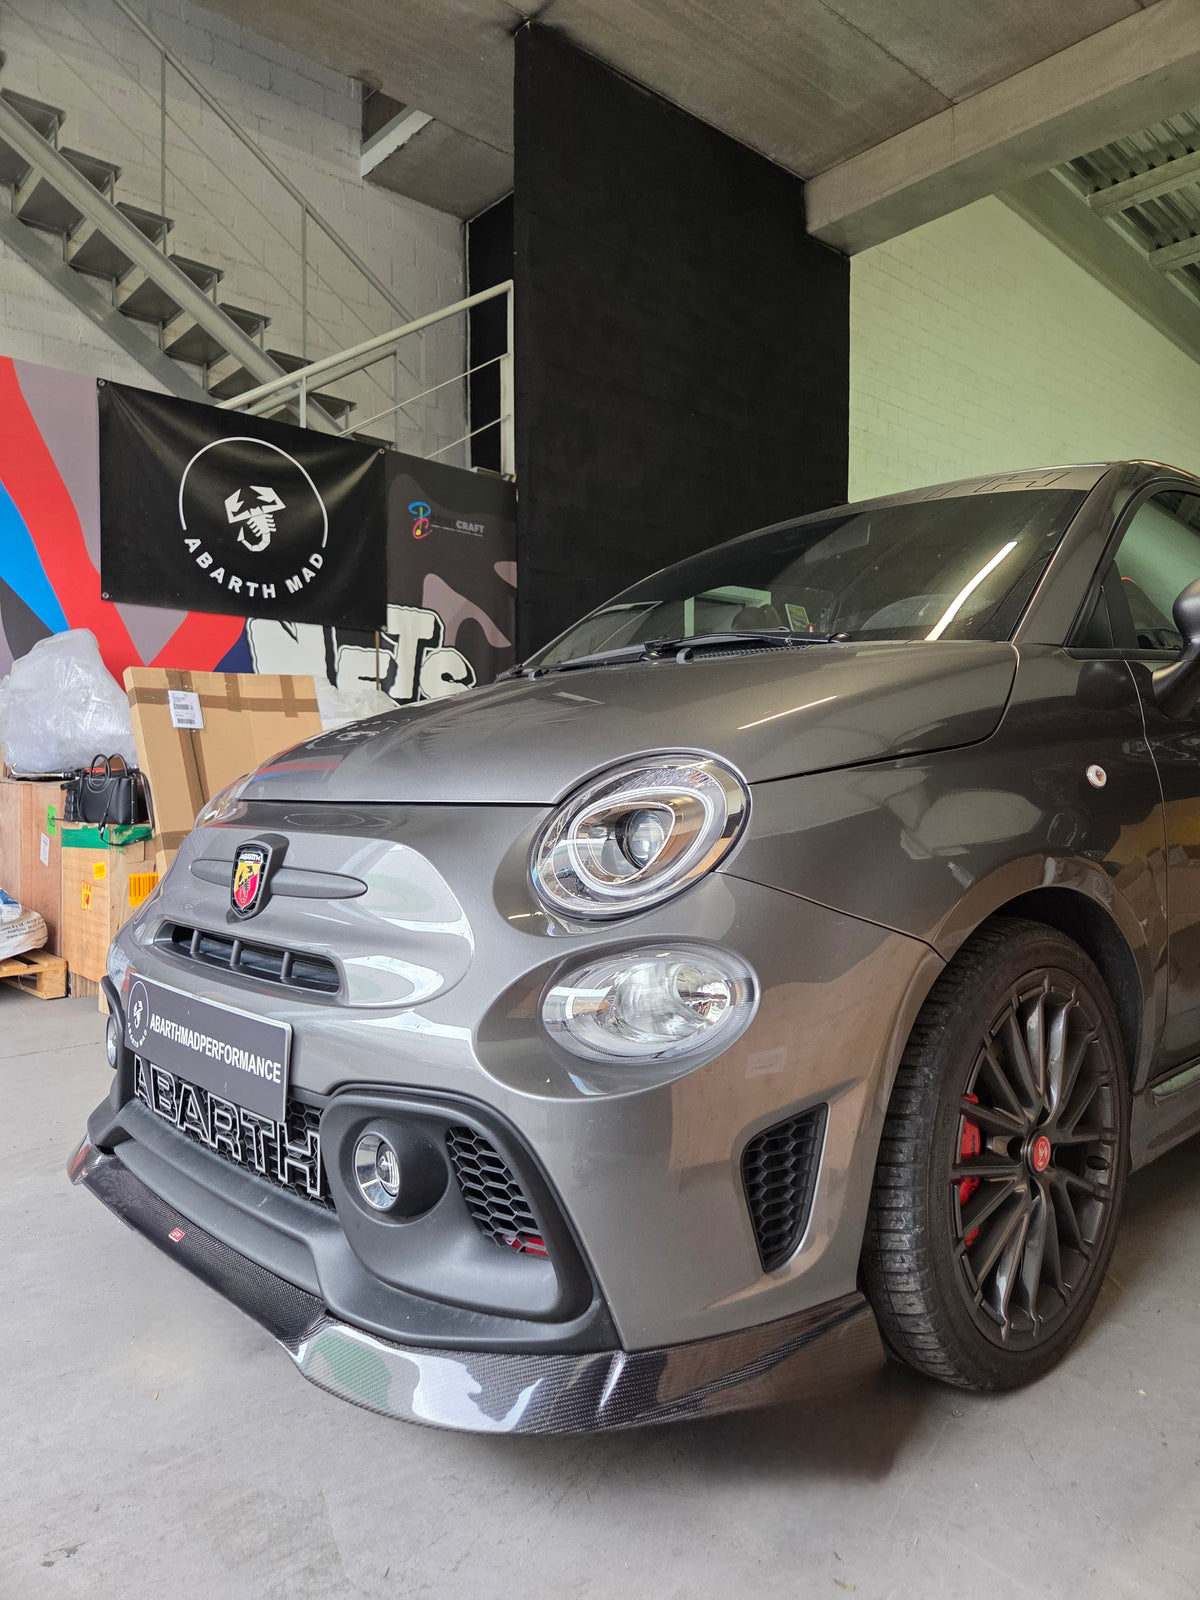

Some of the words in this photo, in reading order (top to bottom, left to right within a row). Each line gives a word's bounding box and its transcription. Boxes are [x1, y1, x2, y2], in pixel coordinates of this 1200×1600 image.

[456, 520, 485, 534] CRAFT
[184, 538, 276, 599] ABARTH
[284, 553, 324, 594] MAD
[150, 1013, 281, 1084] ABARTHMADPERFORMANCE
[134, 1053, 321, 1196] ABARTH
